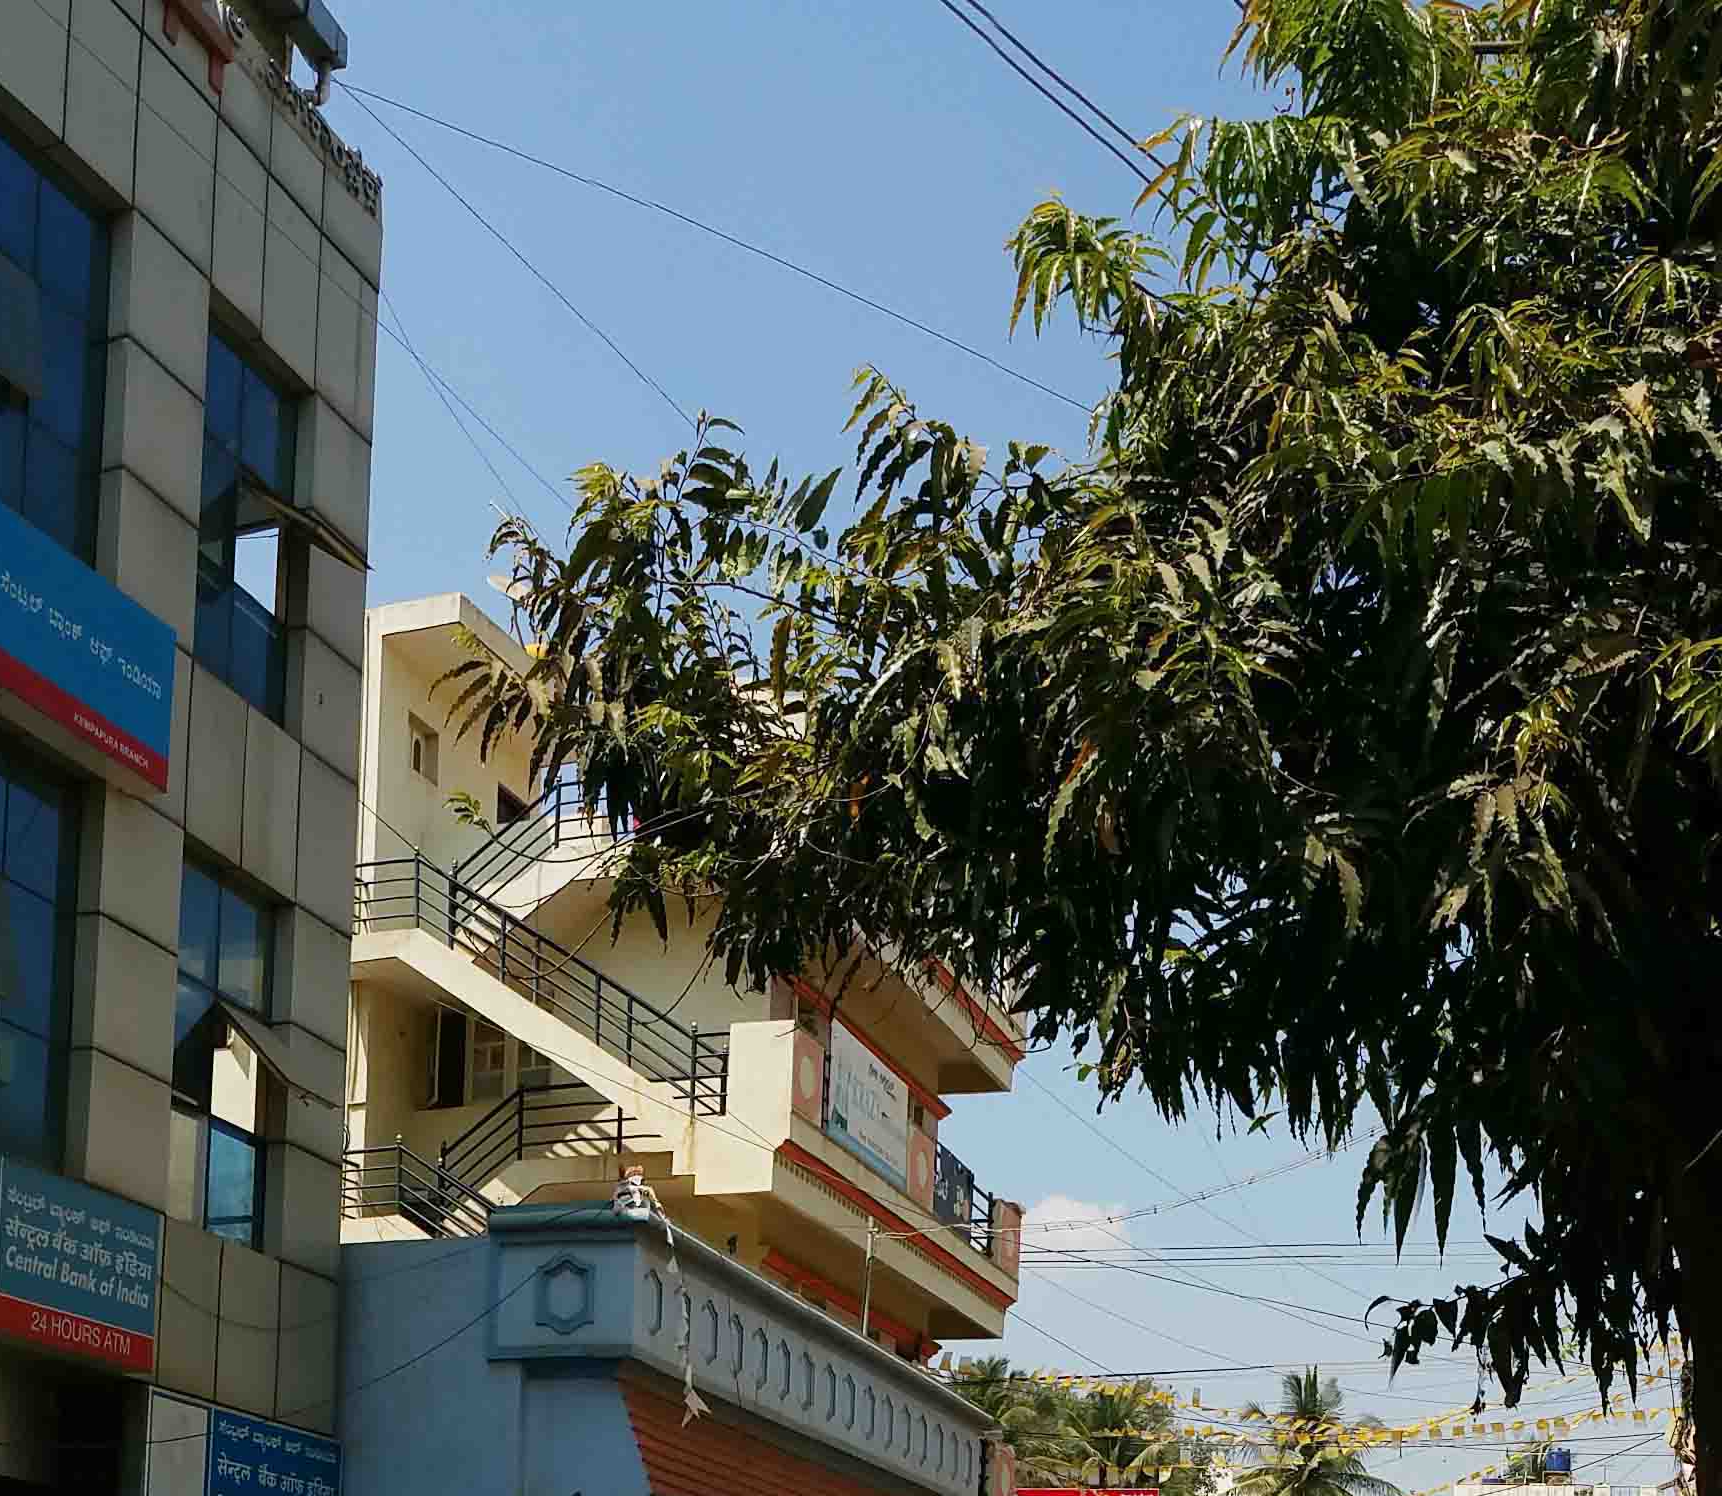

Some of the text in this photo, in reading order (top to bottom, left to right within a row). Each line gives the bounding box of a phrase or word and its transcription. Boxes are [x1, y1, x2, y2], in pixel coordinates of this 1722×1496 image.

[5, 1246, 150, 1309] Central Bank of India
[31, 1311, 131, 1356] 24 HOURS ATM
